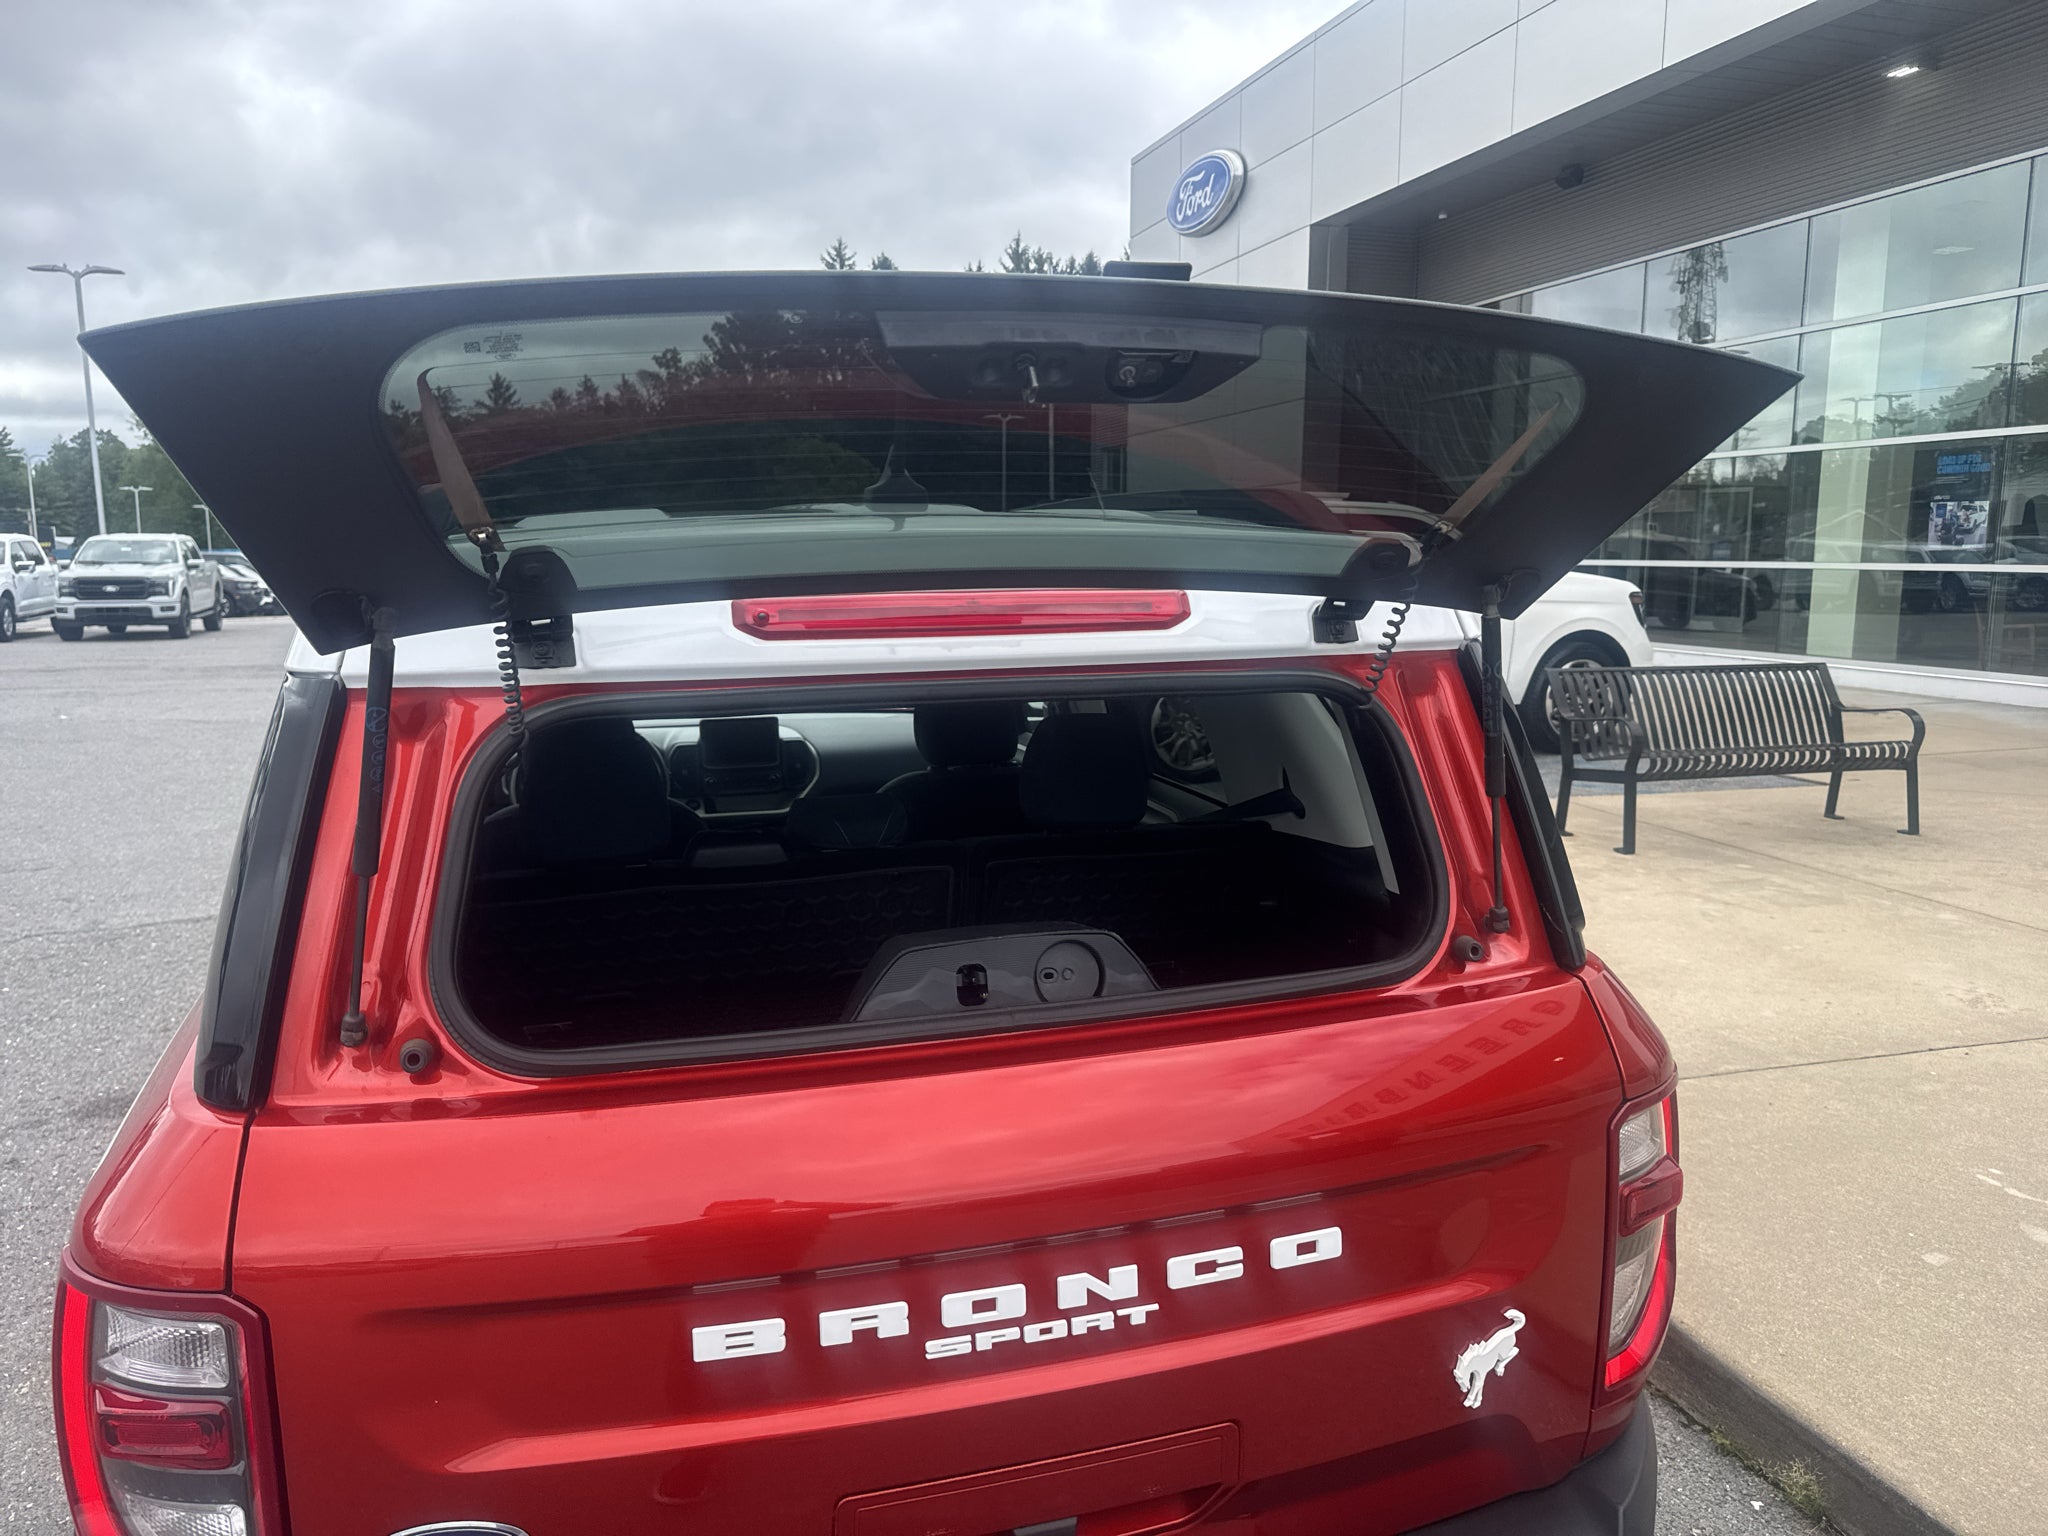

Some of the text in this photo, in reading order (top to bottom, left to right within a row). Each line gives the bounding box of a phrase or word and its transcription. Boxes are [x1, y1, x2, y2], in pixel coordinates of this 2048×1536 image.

[1176, 170, 1216, 222] Ford
[692, 1226, 1342, 1362] BRONCO
[925, 1303, 1160, 1360] SPORT
